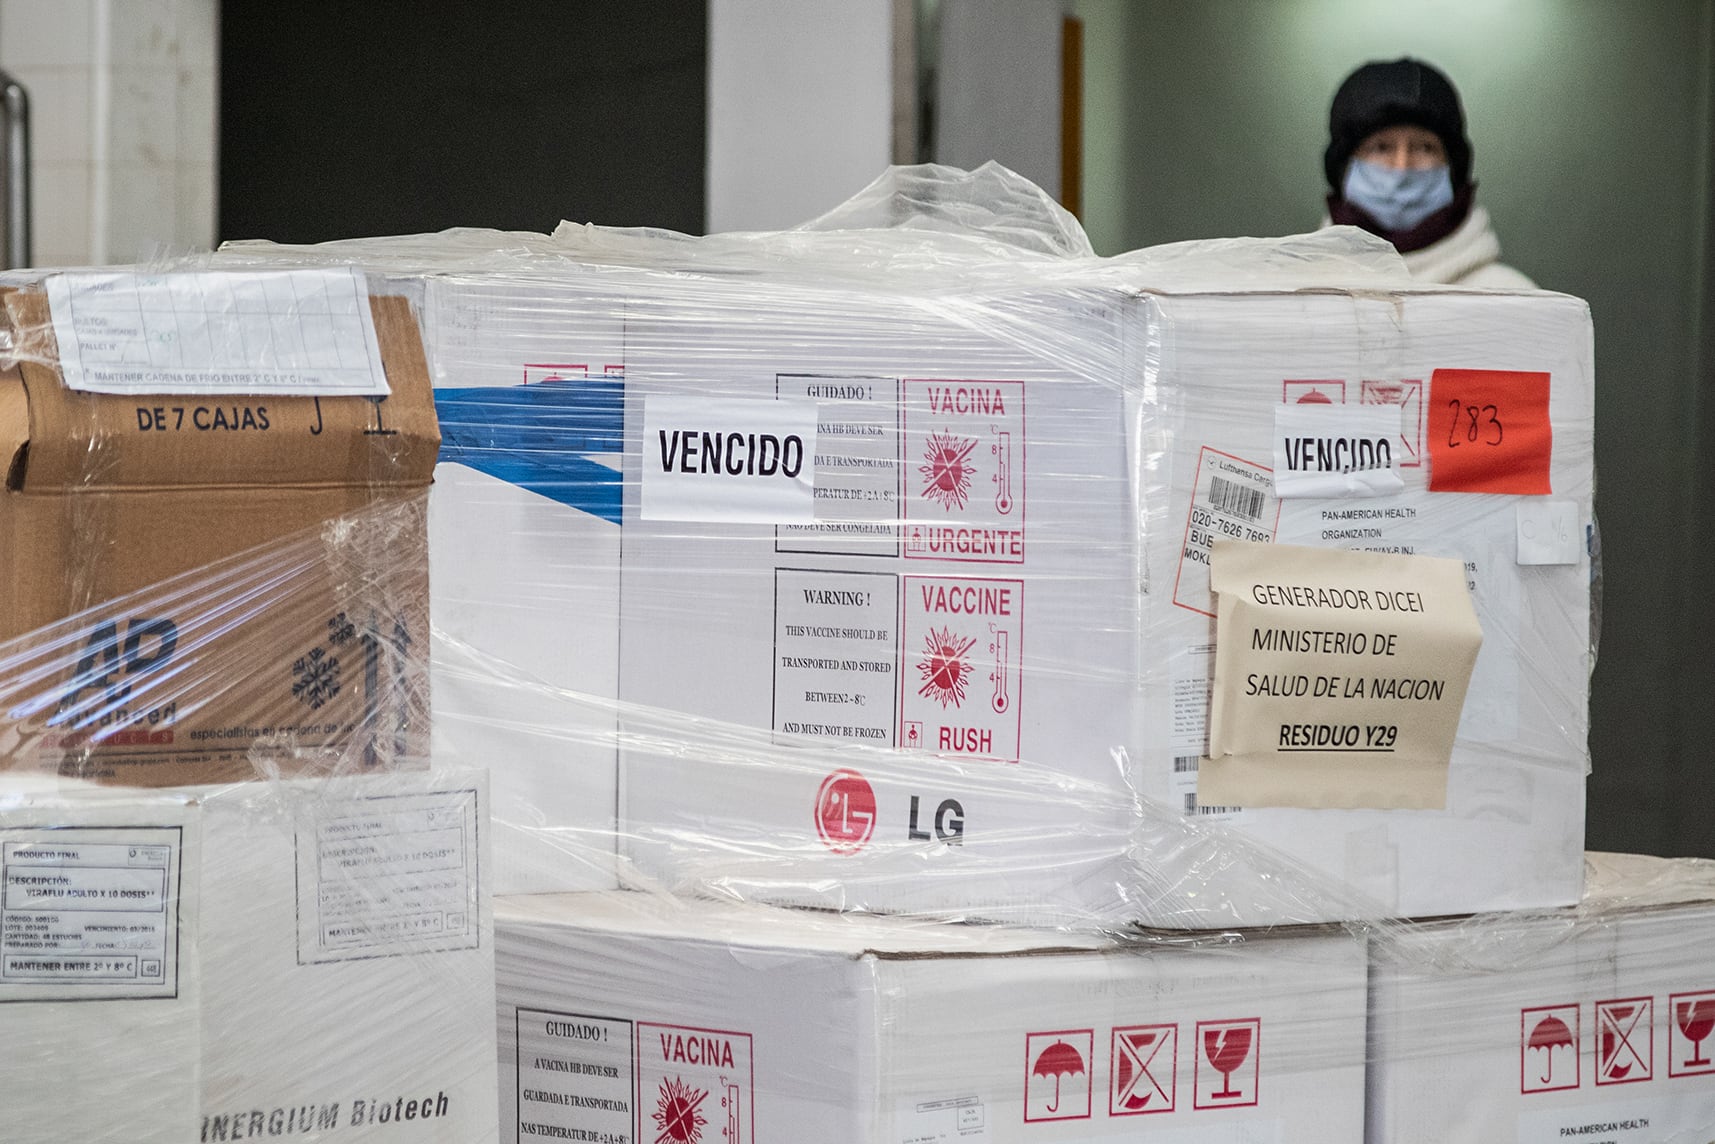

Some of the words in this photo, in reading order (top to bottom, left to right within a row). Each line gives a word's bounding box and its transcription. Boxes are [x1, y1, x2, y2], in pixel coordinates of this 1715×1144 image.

[95, 373, 143, 382] MANTENER
[146, 373, 183, 383] CADENA
[185, 374, 199, 383] DE
[222, 374, 250, 383] ENTRE
[807, 385, 864, 400] GUIDADO
[928, 387, 1005, 415] VACINA
[137, 407, 166, 430] DE
[172, 407, 184, 429] 7
[193, 407, 270, 430] CAJAS
[1448, 400, 1502, 447] 283
[832, 424, 844, 434] HB
[659, 429, 802, 478] VENCIDO
[992, 445, 997, 455] 8
[992, 474, 997, 483] 4
[1219, 461, 1253, 479] Lufthansa
[851, 489, 862, 500] DE
[1322, 510, 1383, 520] PAN-AMERICAN
[1385, 509, 1416, 518] HEALTH
[1192, 510, 1243, 538] 020-7626
[929, 528, 1021, 555] URGENTE
[1191, 530, 1214, 548] BUE
[1322, 529, 1382, 540] ORGANIZATION
[804, 590, 864, 606] WARNING
[922, 584, 1011, 615] VACCINE
[1253, 584, 1373, 610] GENERADOR
[1376, 591, 1425, 612] DICEI
[786, 625, 805, 637] THIS
[806, 626, 841, 639] VACCINE
[842, 628, 876, 640] SHOULD
[877, 630, 888, 640] BE
[989, 643, 995, 653] 8
[1252, 629, 1367, 655] MINISTERIO
[1372, 634, 1398, 656] DE
[782, 657, 839, 670] TRANSPORTED
[841, 660, 858, 671] AND
[859, 661, 891, 673] STORED
[989, 673, 995, 682] 4
[1246, 674, 1309, 697] SALUD
[1313, 677, 1340, 698] DE
[1344, 678, 1365, 699] LA
[1370, 679, 1445, 701] NACION
[190, 726, 260, 740] especialistas
[783, 722, 800, 733] AND
[801, 723, 824, 735] MUST
[825, 725, 841, 736] NOT
[842, 726, 853, 737] BE
[854, 727, 887, 739] FROZEN
[940, 726, 992, 753] RUSH
[1279, 724, 1359, 746] RESIDUO
[1366, 725, 1398, 746] Y29
[908, 795, 965, 846] LG
[13, 851, 55, 859] PRODUCTO
[57, 852, 80, 860] FINAL
[26, 889, 64, 897] VIRAFLU
[67, 890, 98, 898] ADULTO
[101, 890, 106, 898] X
[109, 890, 118, 898] 10
[10, 961, 61, 971] MANTENER
[64, 962, 91, 971] ENTRE
[105, 962, 111, 971] Y
[127, 962, 133, 971] C
[546, 1021, 600, 1041] GUIDADO
[660, 1033, 735, 1069] VACINA
[534, 1058, 540, 1069] A
[541, 1059, 569, 1073] VACINA
[570, 1062, 582, 1074] HB
[582, 1063, 602, 1076] DEVE
[603, 1066, 618, 1078] SER
[523, 1089, 563, 1106] GUARDADA
[564, 1095, 569, 1106] E
[570, 1095, 629, 1113] TRANSPORTADA
[721, 1097, 727, 1107] 8
[200, 1103, 340, 1143] INERGIUM
[350, 1091, 449, 1127] Biotech
[521, 1122, 536, 1134] NAS
[537, 1124, 587, 1141] TEMPERATUR
[588, 1131, 599, 1142] DE
[722, 1128, 728, 1137] 4
[1560, 1122, 1618, 1137] PAN-AMERICAN
[1619, 1119, 1649, 1130] HEALTH
